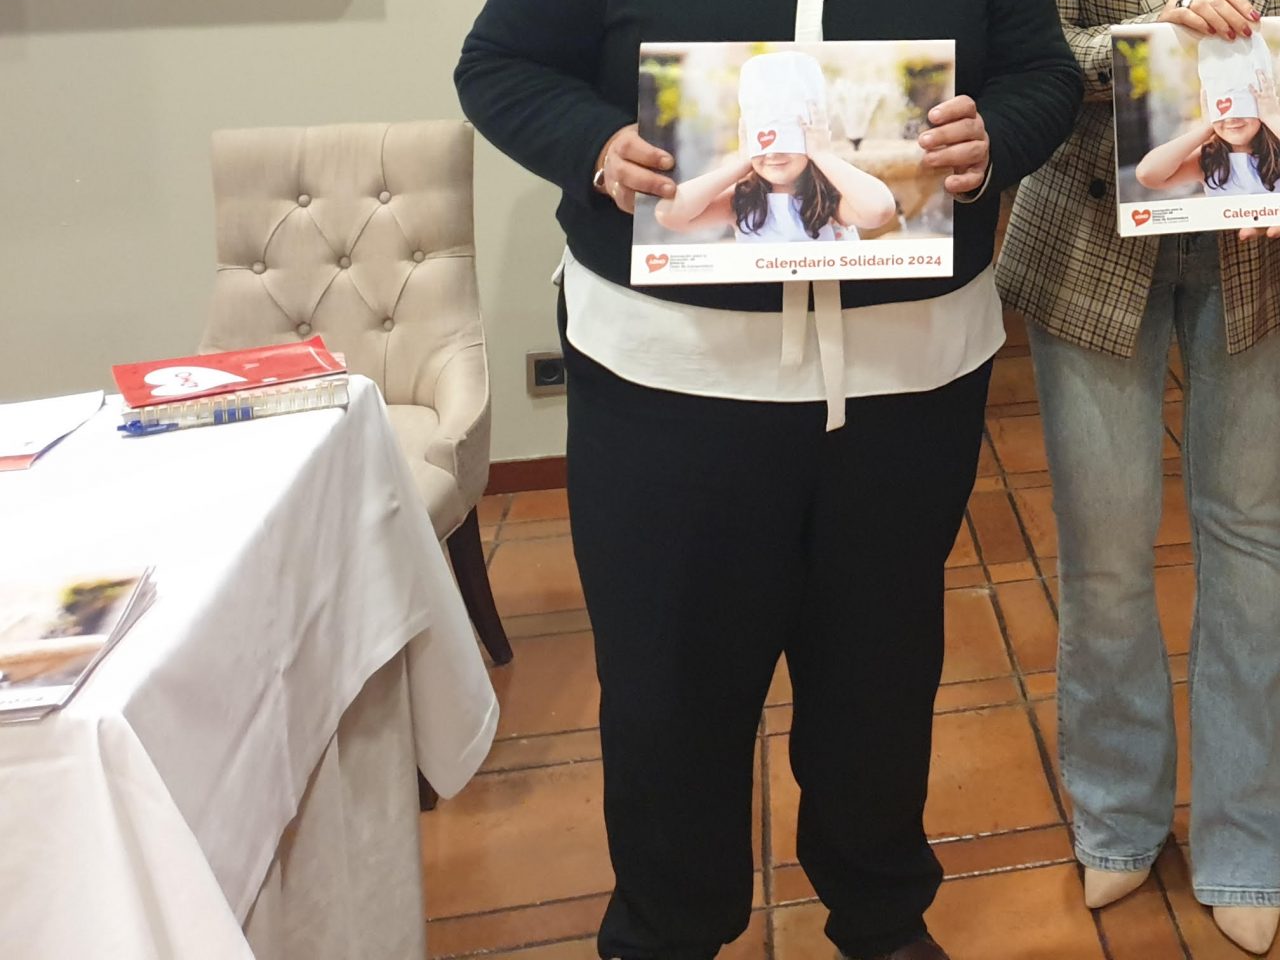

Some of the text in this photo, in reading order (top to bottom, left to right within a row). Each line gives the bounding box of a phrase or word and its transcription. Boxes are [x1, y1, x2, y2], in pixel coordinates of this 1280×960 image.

[755, 255, 942, 269] Calendario Solidario 2024
